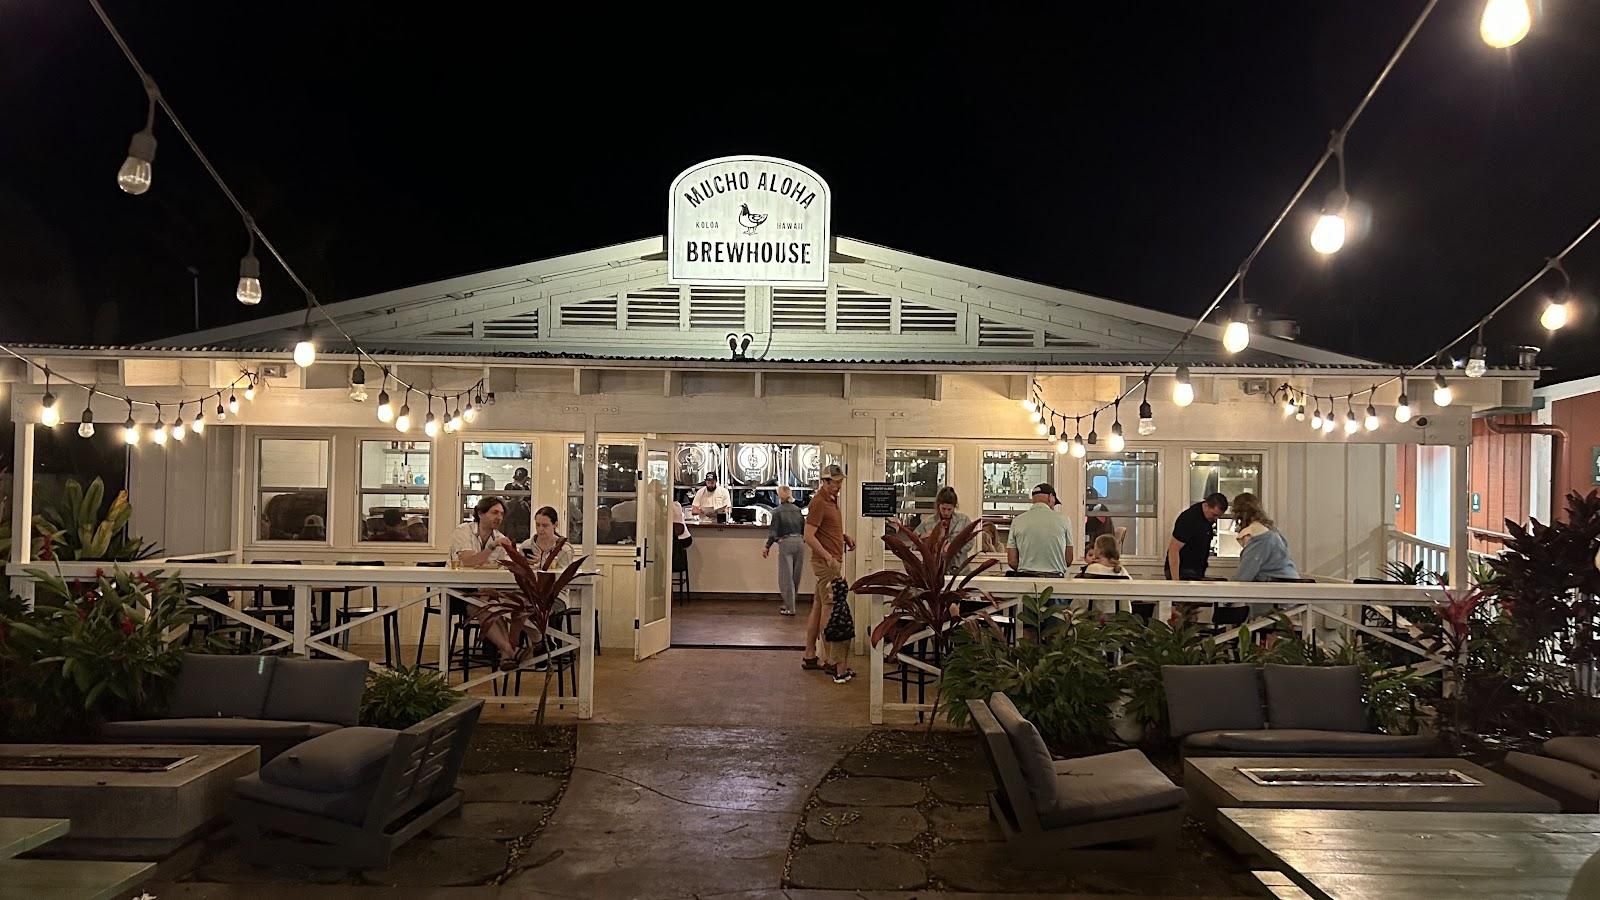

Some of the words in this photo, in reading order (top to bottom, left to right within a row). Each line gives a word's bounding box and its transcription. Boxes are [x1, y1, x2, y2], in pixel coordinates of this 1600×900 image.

[684, 171, 749, 208] MUCHO
[757, 172, 816, 209] ALOHA
[695, 221, 719, 229] KOLOA
[776, 222, 803, 230] HAWAII
[686, 241, 811, 264] BREWHOUSE
